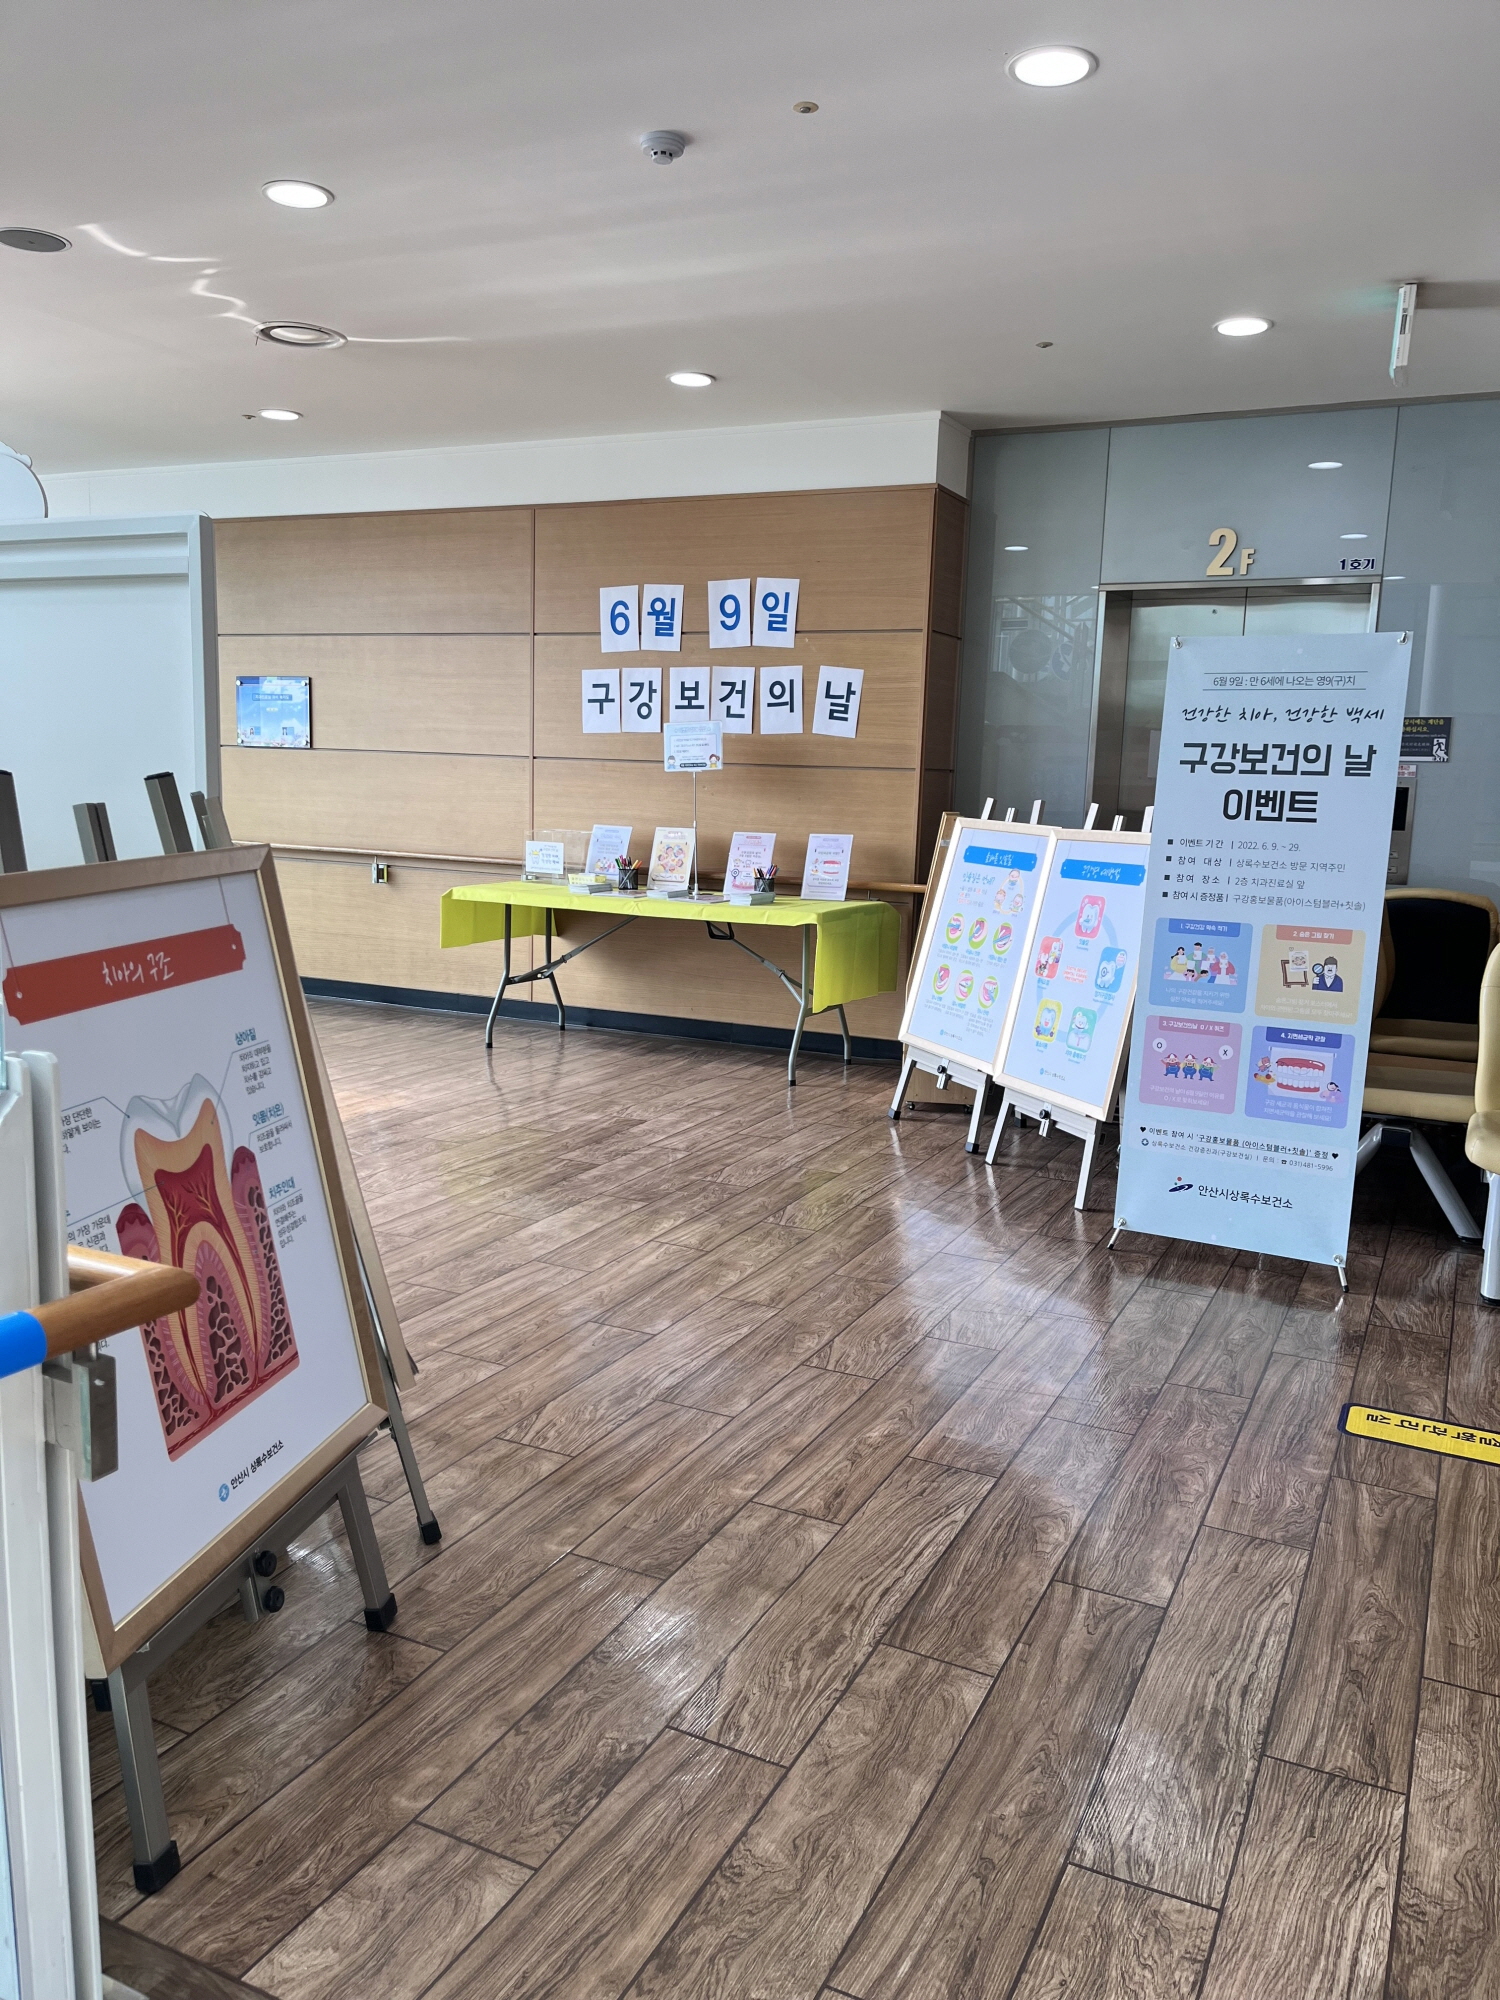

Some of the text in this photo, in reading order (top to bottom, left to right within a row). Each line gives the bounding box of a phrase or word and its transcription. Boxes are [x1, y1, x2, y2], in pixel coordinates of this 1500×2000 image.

[610, 592, 790, 637] 6월 9일
[1213, 677, 1227, 687] 6월
[1229, 677, 1244, 687] 9일
[1249, 677, 1259, 687] 만
[1260, 677, 1284, 687] 6세에
[1285, 676, 1314, 687] 나오는
[1316, 676, 1355, 687] 영9(구)치
[587, 679, 856, 721] 구강보건의 날
[1182, 705, 1384, 724] 건강한 치아, 건강한 백세
[1179, 743, 1377, 777] 구강보건의 날
[1222, 789, 1319, 823] 이벤트
[1180, 838, 1203, 848] 이벤트
[1205, 839, 1224, 849] 기간
[1178, 856, 1346, 873] 참여 대상 상록수보건소 방문 지역주민
[1176, 873, 1305, 889] 참여 장소 2층 치과진료실 앞
[1172, 890, 1366, 912] 참여 시 증정품 구강홍보물품(아이스텀블러+칫솔)
[102, 952, 174, 986] 치아의 구조
[235, 1027, 256, 1046] 상아질
[72, 1107, 93, 1123] 단단한
[252, 1101, 284, 1126] 잇몸(치은)
[82, 1119, 101, 1133] 보이는
[1149, 1127, 1168, 1136] 이벤트
[1171, 1130, 1184, 1138] 참여
[1314, 1150, 1329, 1159] 증정
[1151, 1140, 1186, 1150] 상록수보건소
[268, 1176, 296, 1199] 치주인대
[1198, 1185, 1293, 1209] 안산시상록수보건소
[76, 1224, 90, 1237] 가장
[91, 1214, 111, 1230] 가운데
[230, 1439, 284, 1490] 안산시 상록수보건소
